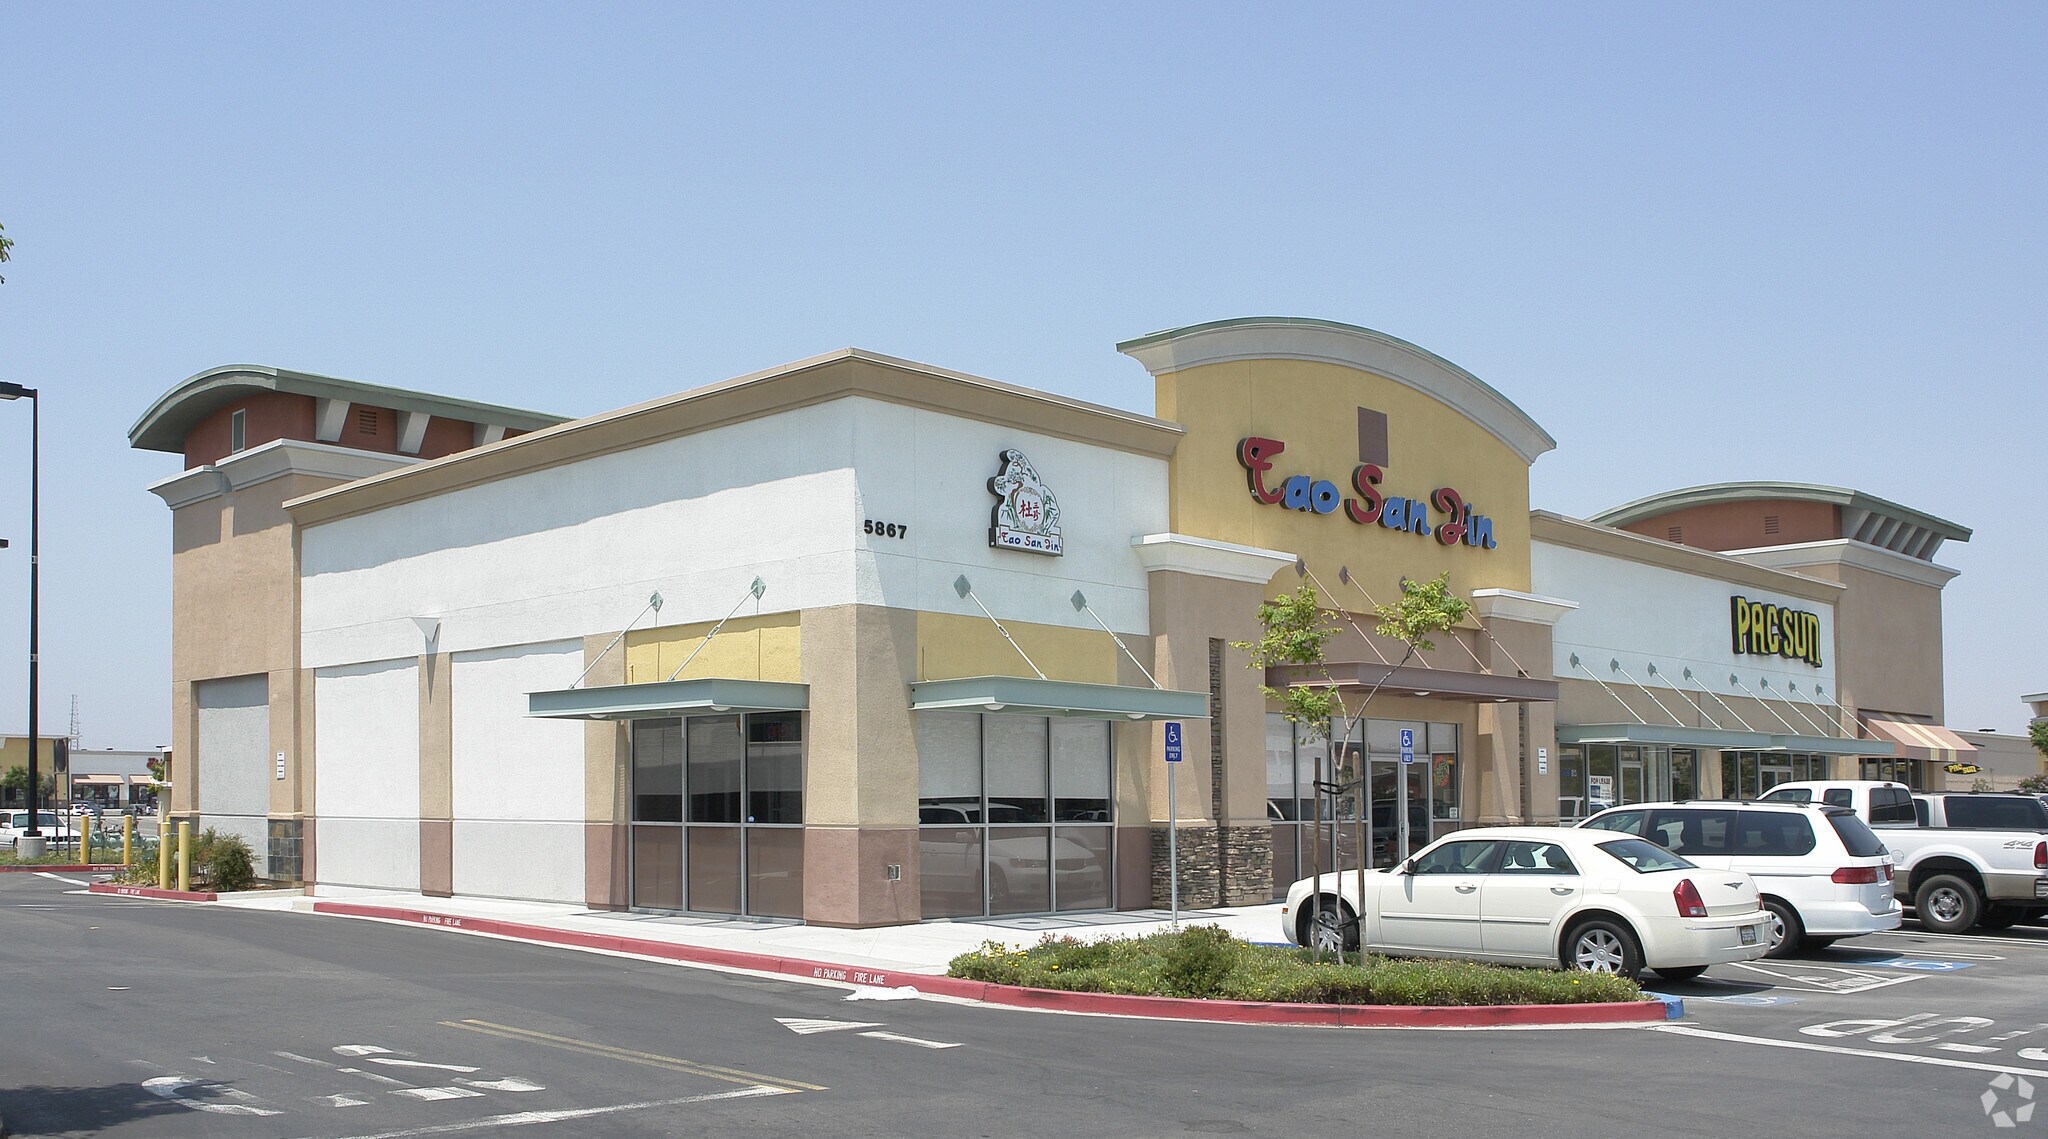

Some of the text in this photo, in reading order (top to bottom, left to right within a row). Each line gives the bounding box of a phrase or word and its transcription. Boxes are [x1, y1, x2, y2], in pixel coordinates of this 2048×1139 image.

[1238, 437, 1497, 549] Tao San Jin
[864, 519, 907, 539] 5867
[1001, 532, 1021, 545] Tao
[1024, 535, 1042, 548] San
[1169, 752, 1178, 760] ONLY
[1599, 777, 1611, 785] LEASE
[813, 967, 885, 985] NO PARKING FIRE LANE
